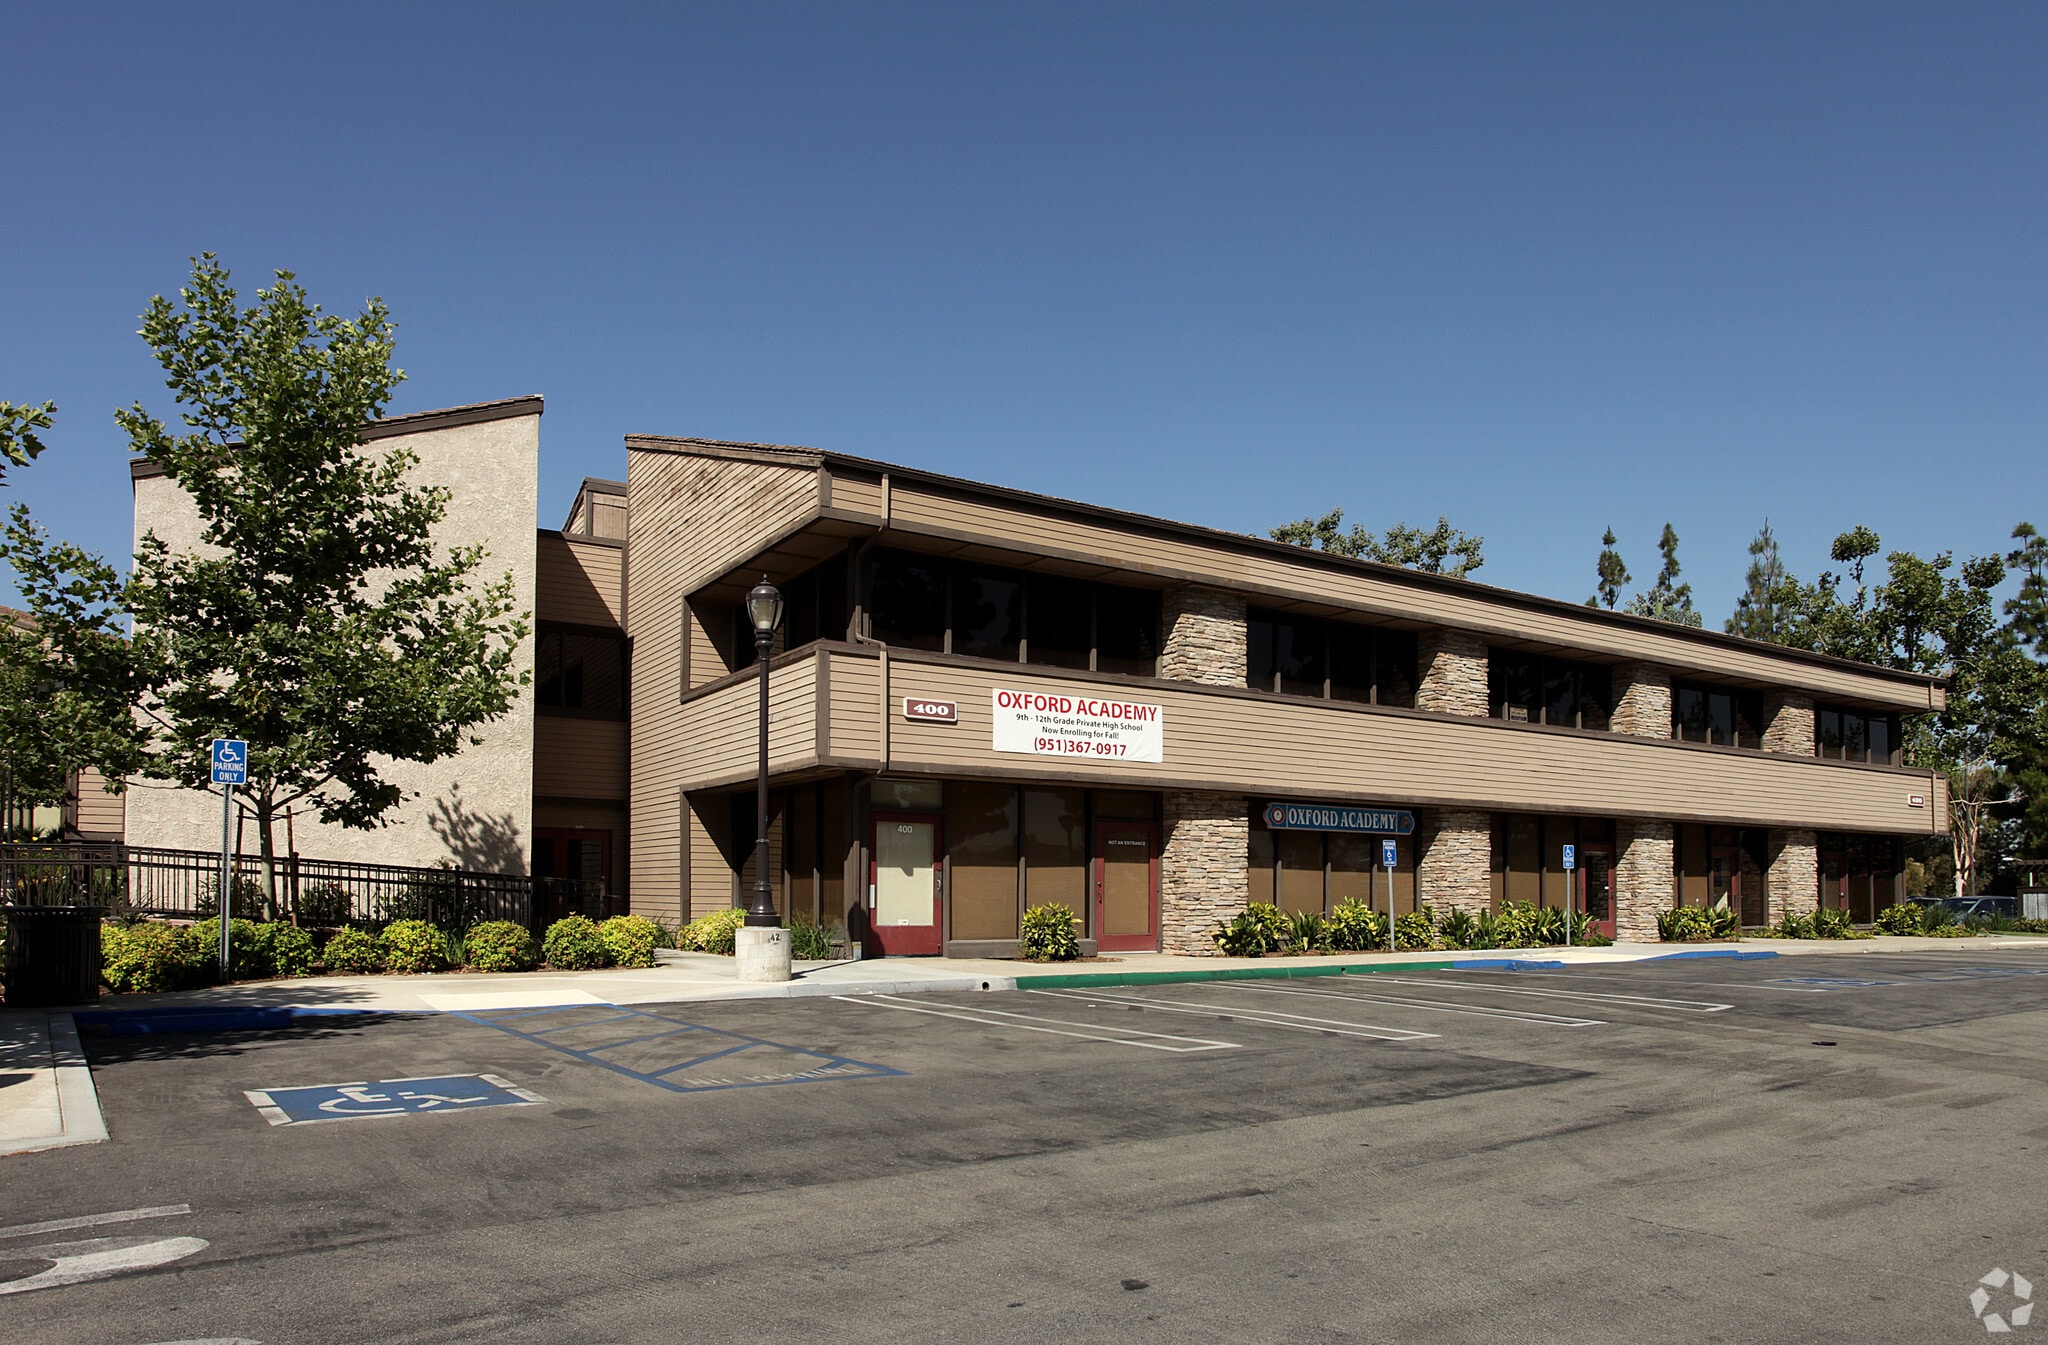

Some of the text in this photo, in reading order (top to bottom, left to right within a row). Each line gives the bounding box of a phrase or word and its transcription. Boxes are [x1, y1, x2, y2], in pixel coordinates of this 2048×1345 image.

[913, 703, 949, 716] 400
[997, 691, 1157, 721] OXFORD ACADEMY
[1016, 713, 1029, 721] 9th
[1035, 714, 1052, 723] 12th
[1053, 716, 1075, 726] Grade
[1076, 718, 1101, 728] Private
[1102, 721, 1119, 731] High
[1120, 722, 1143, 732] School
[1042, 726, 1120, 740] Now Enrolling for Fall!
[1034, 737, 1127, 756] (951)367-0917
[214, 761, 244, 772] PARKING
[219, 771, 238, 782] ONLY
[1288, 808, 1395, 830] OXFORD ACADEMY
[897, 825, 913, 834] 400
